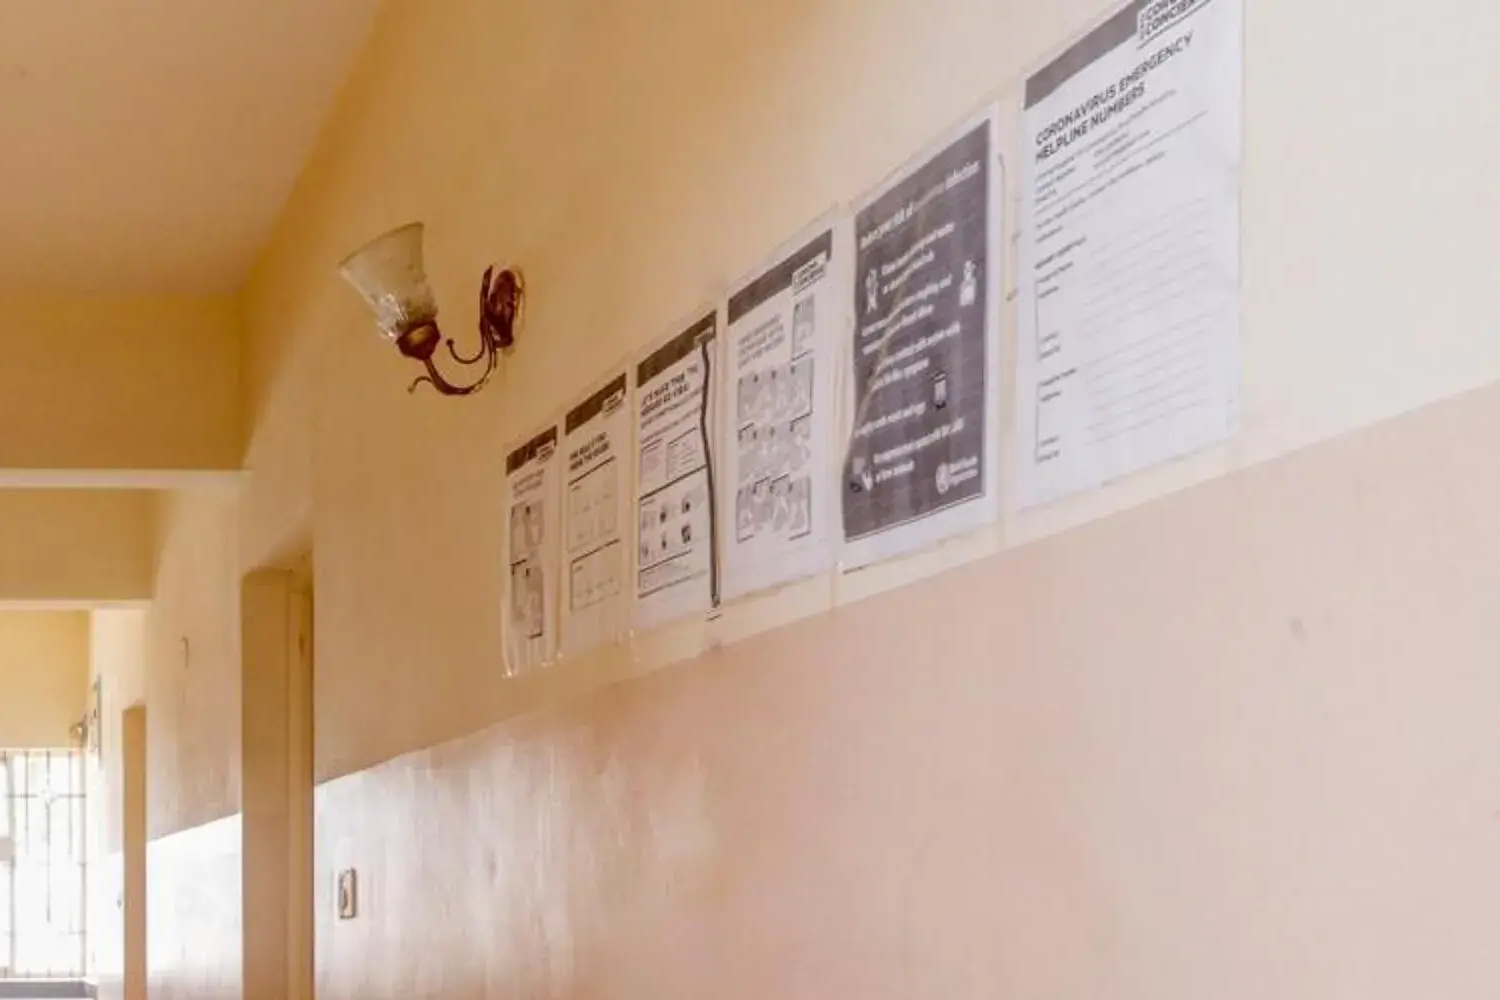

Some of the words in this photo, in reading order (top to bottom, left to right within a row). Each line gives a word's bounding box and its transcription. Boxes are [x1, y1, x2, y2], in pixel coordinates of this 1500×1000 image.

[1035, 83, 1116, 146] CORONAVIRUS
[1118, 29, 1194, 93] EMERGENCY
[1035, 119, 1089, 164] HELPLINE
[1090, 80, 1146, 129] NUMBERS
